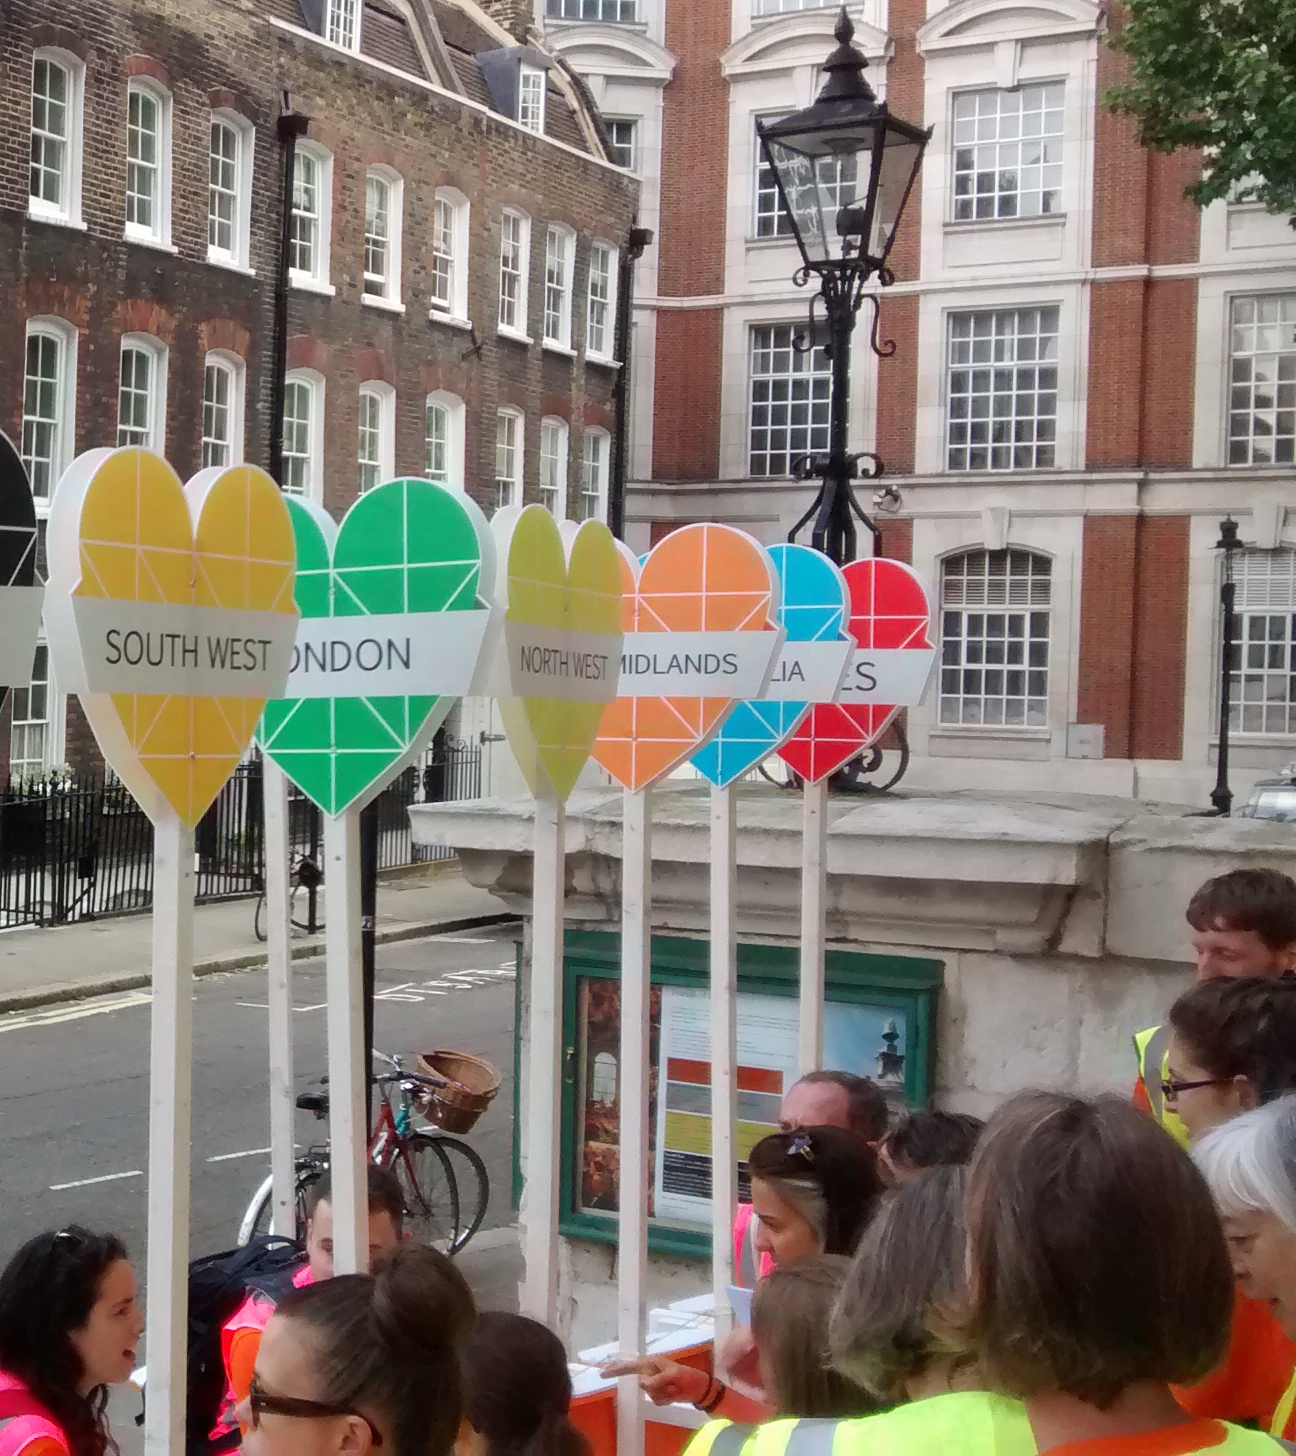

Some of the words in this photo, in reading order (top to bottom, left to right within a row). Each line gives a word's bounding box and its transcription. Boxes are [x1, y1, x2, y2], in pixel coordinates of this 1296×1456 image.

[105, 629, 199, 668] SOUTH
[206, 635, 272, 672] WEST
[520, 645, 569, 677] NORTH
[572, 651, 609, 681] WEST
